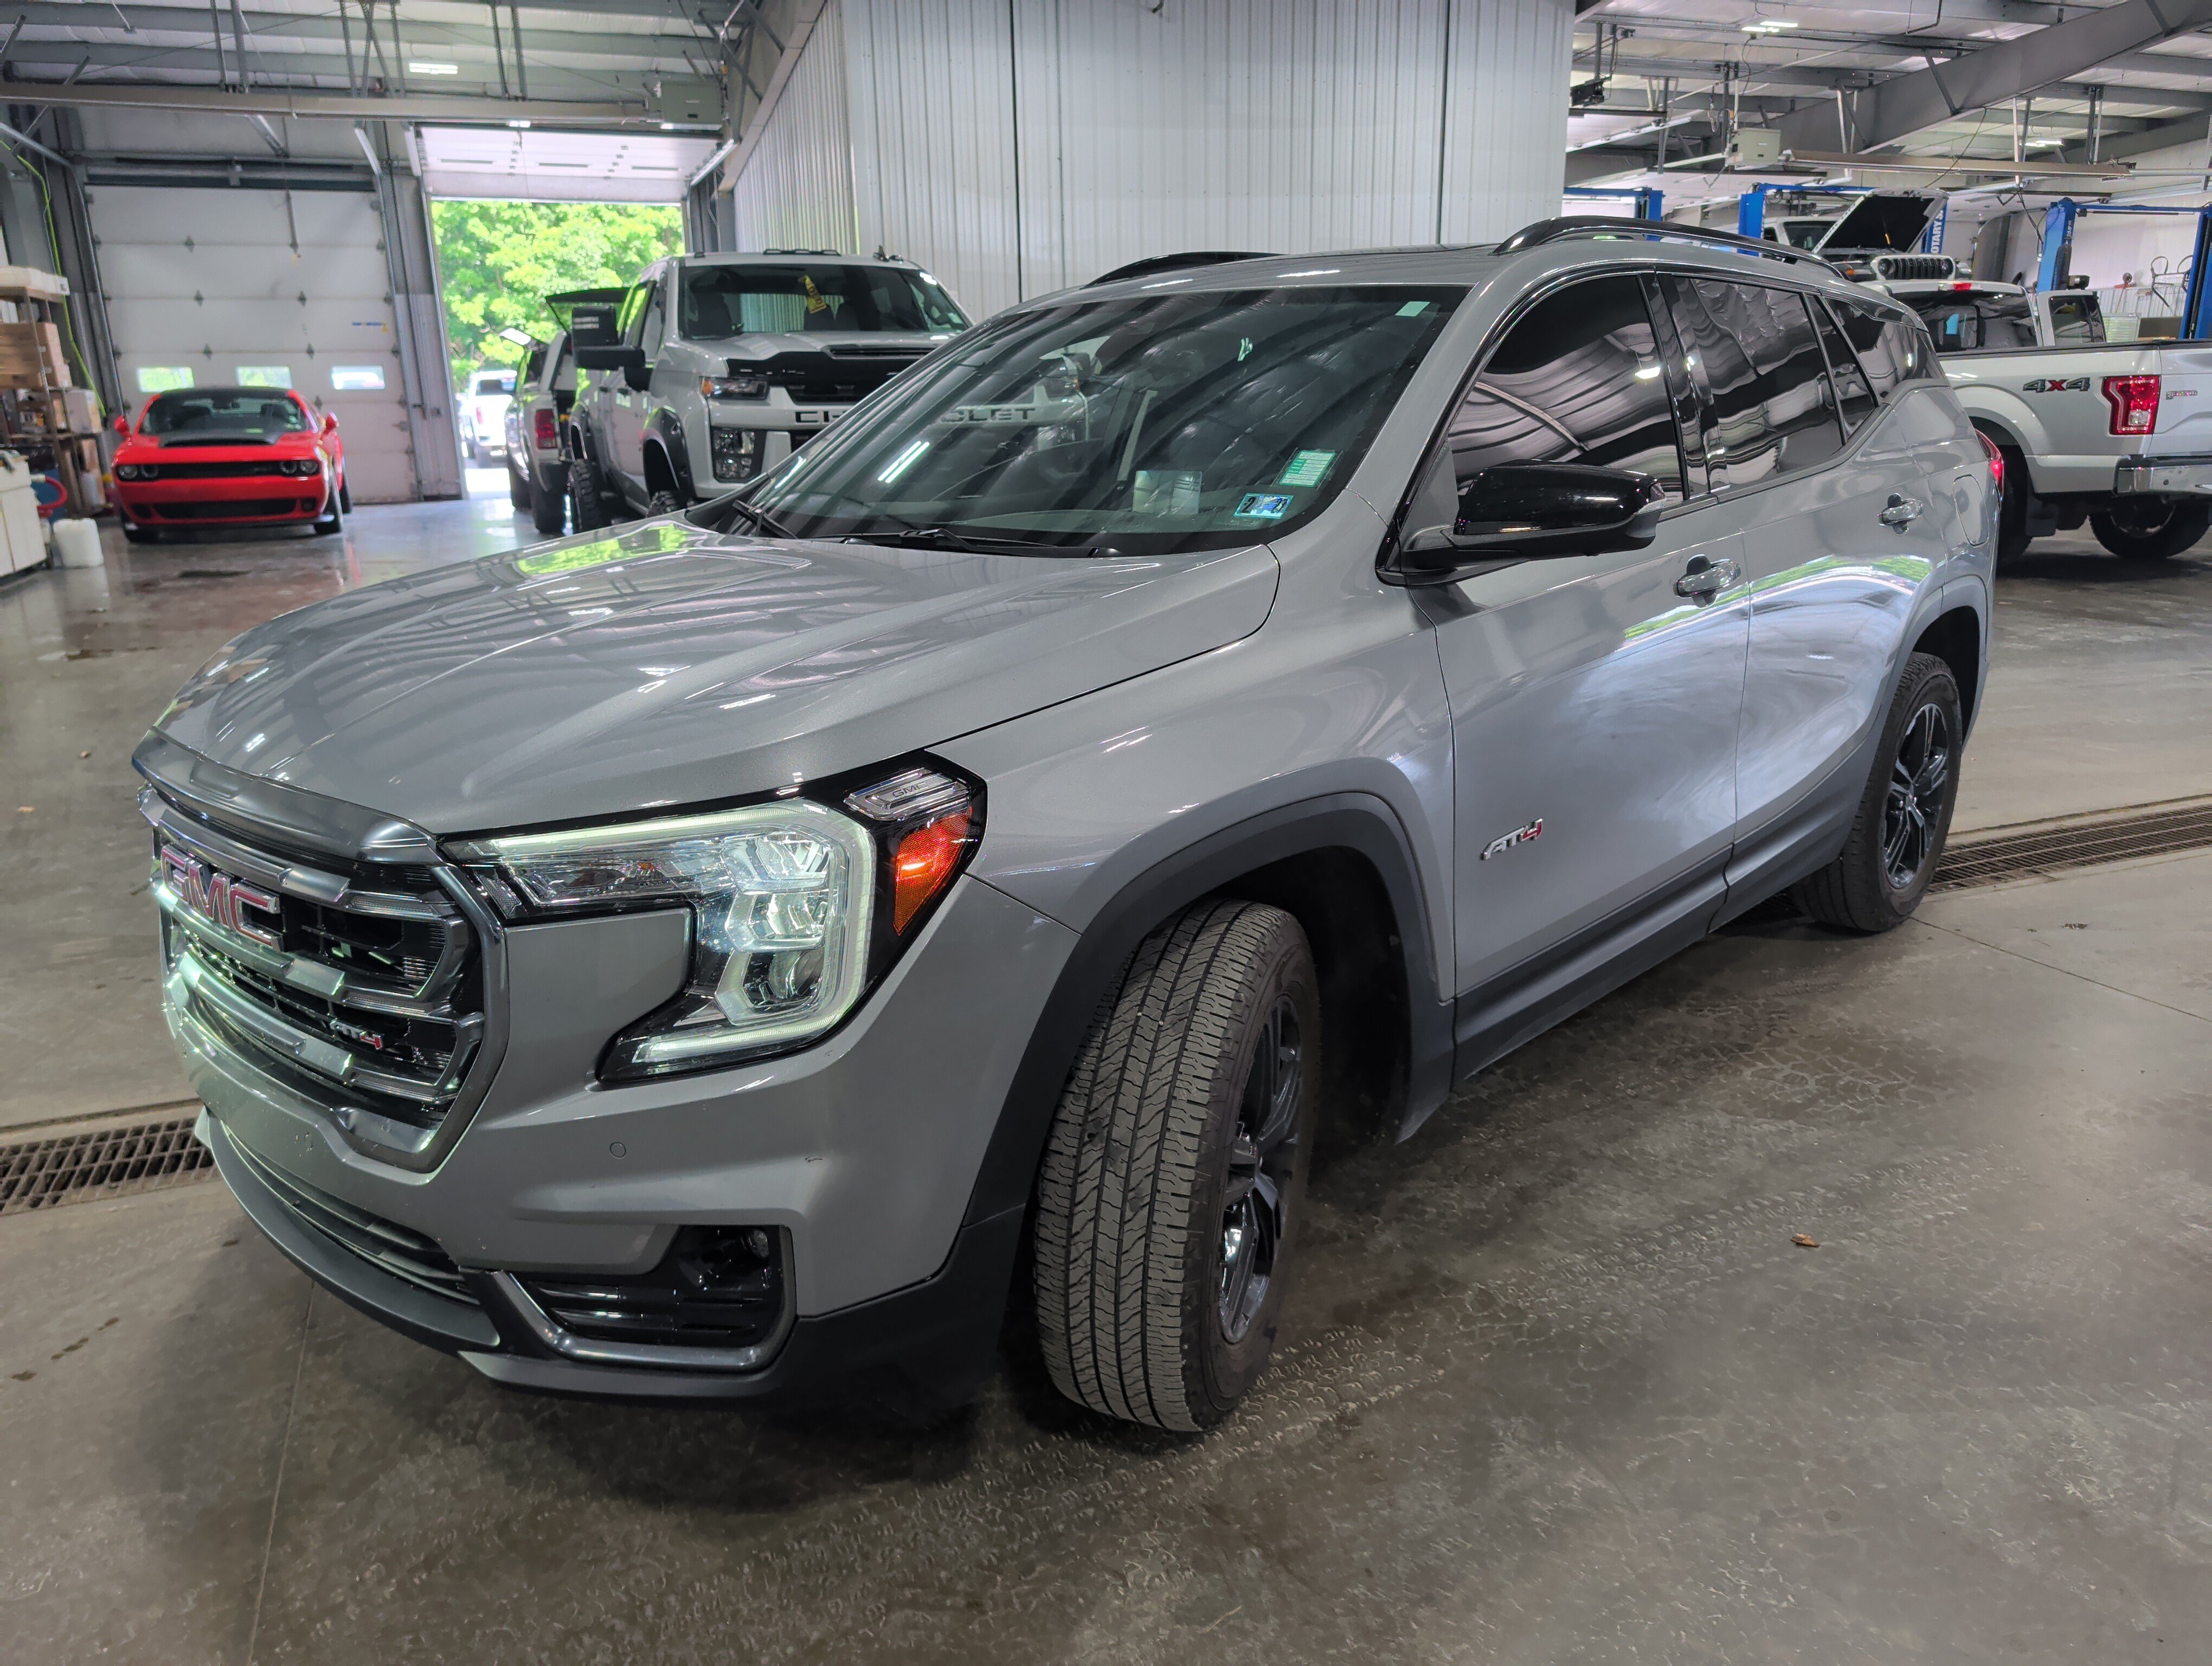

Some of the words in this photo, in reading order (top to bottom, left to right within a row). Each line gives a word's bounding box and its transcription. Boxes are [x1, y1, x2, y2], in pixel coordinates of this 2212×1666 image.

[1931, 221, 1943, 254] OTARY
[891, 782, 928, 798] GMC
[1483, 818, 1543, 860] AT4
[160, 844, 284, 952] GMC
[330, 1017, 384, 1050] AT4
